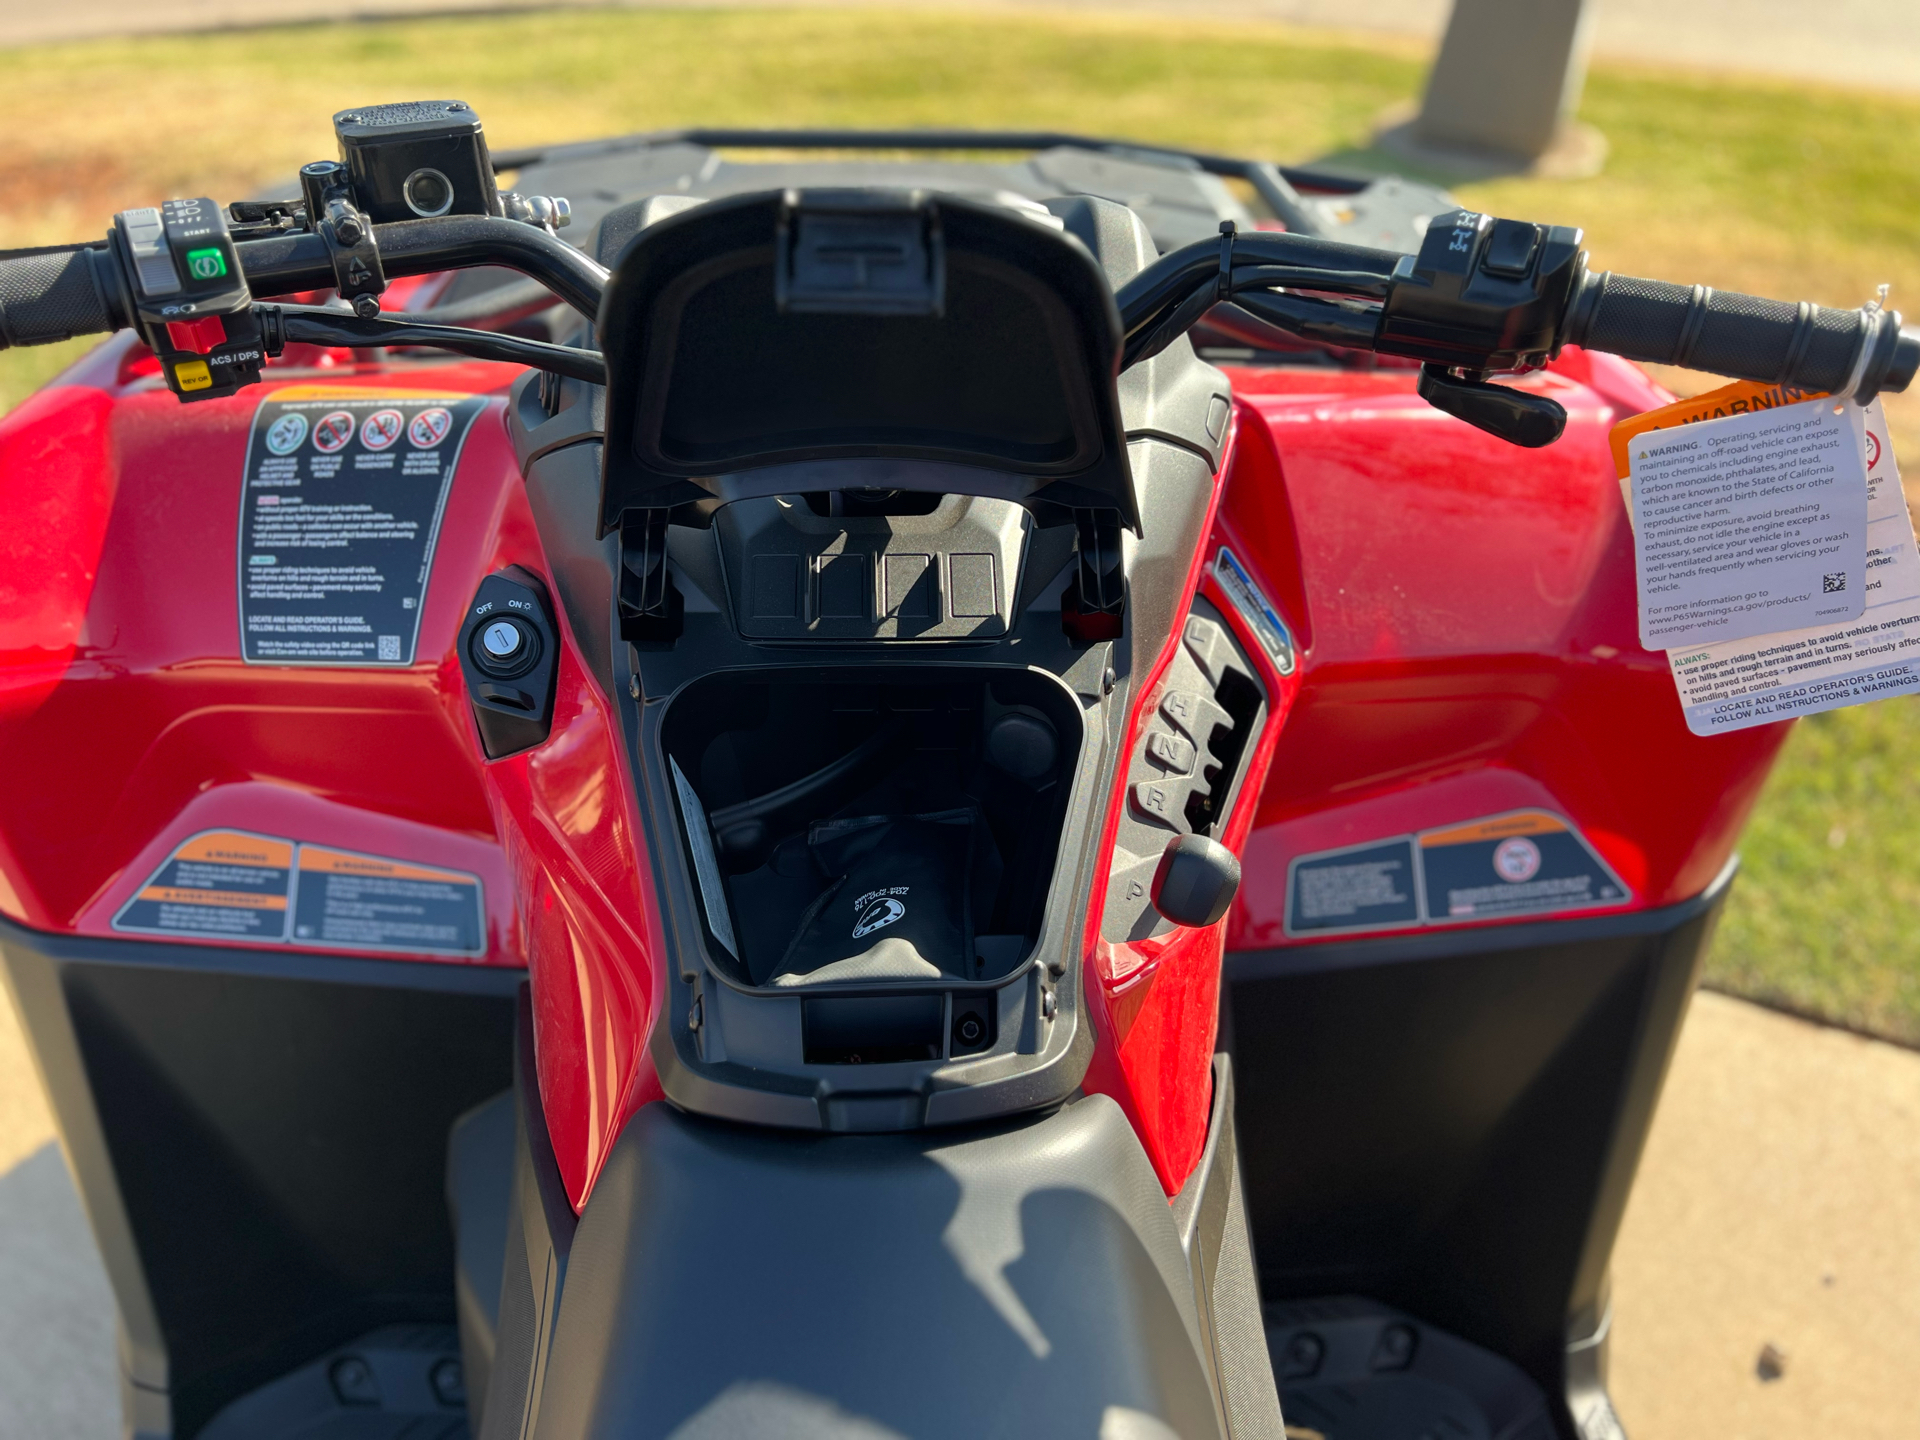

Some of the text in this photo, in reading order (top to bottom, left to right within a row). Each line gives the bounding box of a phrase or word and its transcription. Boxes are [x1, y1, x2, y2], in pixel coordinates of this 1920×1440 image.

[178, 216, 202, 224] OFF
[184, 228, 210, 236] START
[211, 354, 232, 366] ACS
[239, 350, 260, 361] DPS
[1706, 431, 1758, 447] Operating,
[1758, 422, 1801, 437] servicing
[1802, 416, 1822, 428] and
[1639, 427, 1839, 471] maintaining an off-road vehicle can expose
[1639, 439, 1840, 485] you to chemicals including engine exhaust,
[1640, 453, 1822, 495] carbon monoxide, phthalates, and lead,
[1641, 464, 1835, 506] which are known to the State of California
[1642, 477, 1834, 518] to cause cancer and birth defects or other
[1643, 508, 1731, 529] reproductive harm.
[1643, 503, 1820, 540] To minimize exposure, avoid breathing
[1644, 513, 1830, 551] exhaust, do not idle the engine except as
[1645, 529, 1801, 562] necessary, service your vehicle in a
[1645, 531, 1849, 573] well-ventilated area and wear gloves or wash
[1645, 545, 1840, 586] your hands frequently when servicing your
[1646, 582, 1681, 594] vehicle.
[1647, 607, 1663, 615] For
[1663, 603, 1688, 613] more
[1689, 594, 1743, 608] information
[1743, 592, 1757, 601] go
[248, 616, 365, 624] LOCATE AND READ OPERATOR'S GUIDE.
[476, 599, 522, 615] OFF ON
[1647, 592, 1812, 625] www.P65Warnings.ca.gov/products/
[1190, 622, 1204, 643] L
[1648, 617, 1729, 637] passenger-vehicle
[1674, 652, 1711, 667] ALWAYS:
[1682, 666, 1699, 676] use
[1700, 658, 1729, 673] proper
[1729, 652, 1756, 664] riding
[1756, 640, 1807, 658] techniques
[1807, 638, 1818, 646] to
[1818, 630, 1844, 644] avoid
[1844, 624, 1879, 638] vehicle
[1685, 642, 1853, 685] on hills and rough terrain and in turns.
[1688, 682, 1712, 695] avoid
[1713, 676, 1740, 690] paved
[1740, 669, 1780, 683] surfaces
[1786, 656, 1832, 674] pavement
[1832, 652, 1852, 663] may
[1854, 642, 1896, 658] seriously
[1691, 678, 1782, 704] handling and control.
[1713, 665, 1913, 714] LOCATE AND READ OPERATOR'S GUIDE.
[1170, 695, 1188, 717] H
[1710, 709, 1751, 725] FOLLOW
[1754, 705, 1774, 716] ALL
[1774, 689, 1851, 711] INSTRUCTIONS
[1852, 687, 1861, 696] &
[1159, 740, 1178, 762] N
[1147, 787, 1166, 812] R
[1126, 879, 1144, 900] P
